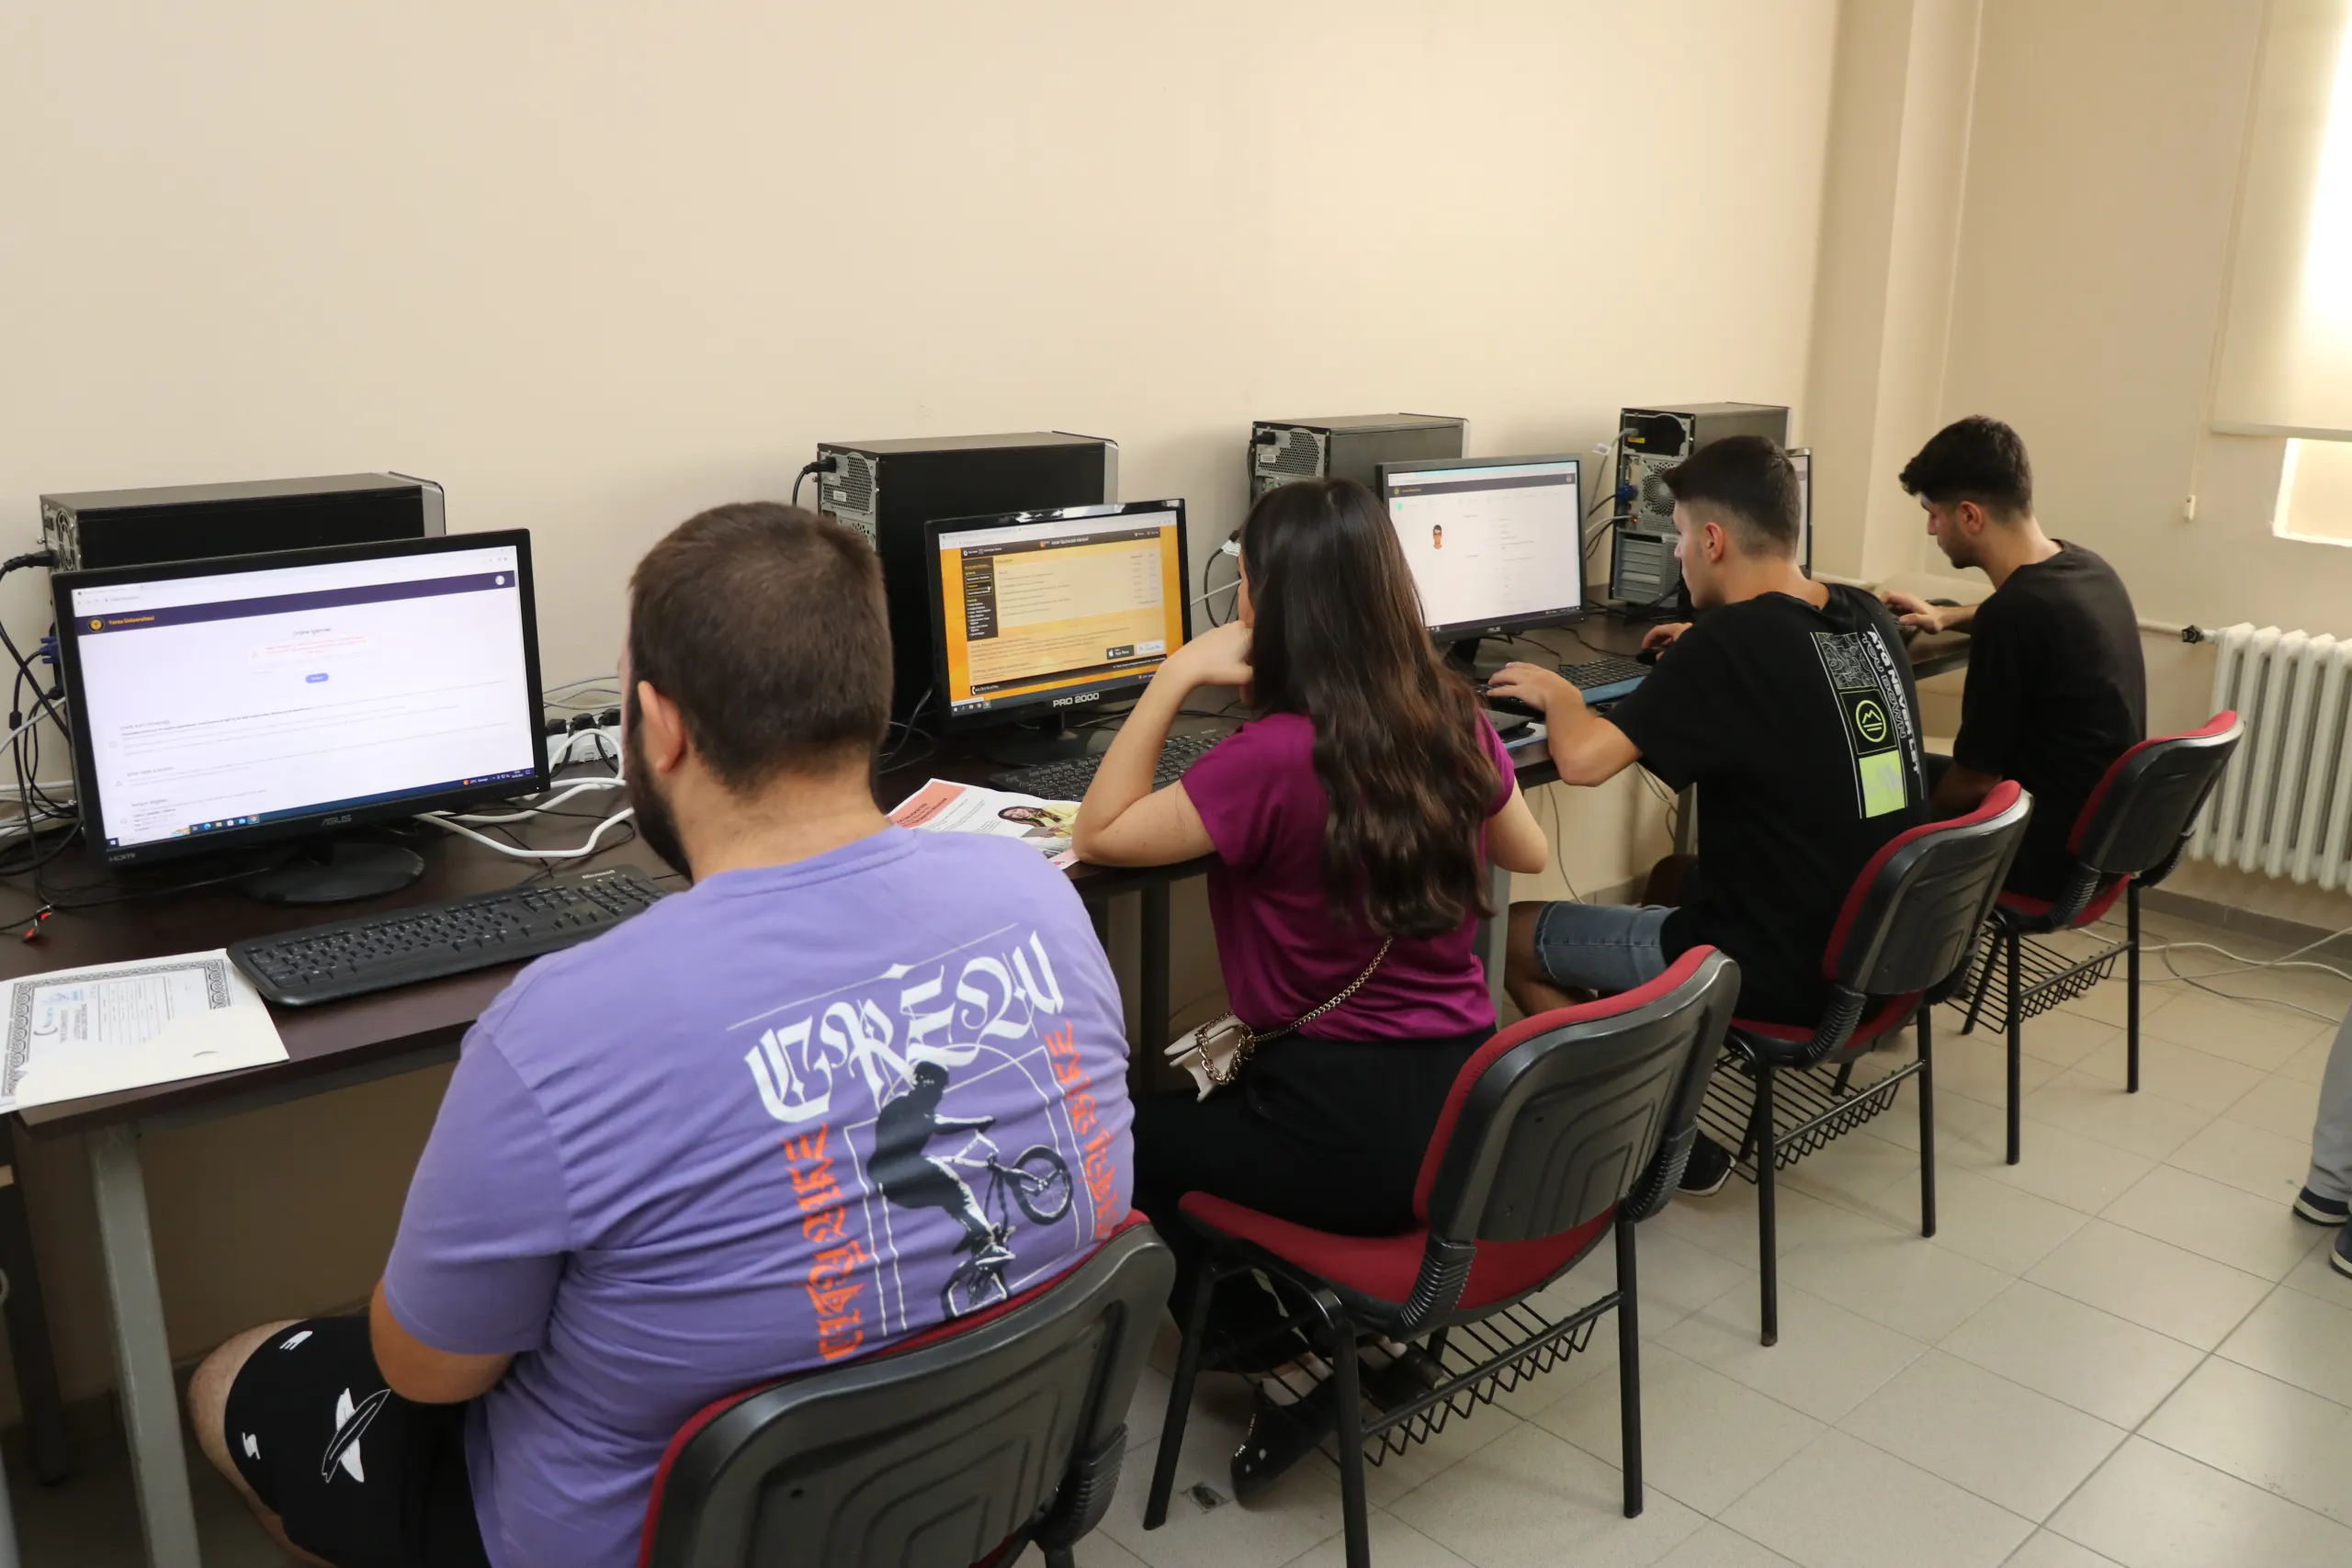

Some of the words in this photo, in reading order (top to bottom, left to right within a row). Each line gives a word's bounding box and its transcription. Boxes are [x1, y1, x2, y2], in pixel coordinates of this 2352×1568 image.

[1053, 697, 1073, 707] PRO
[1075, 693, 1100, 703] 2000
[1881, 675, 1906, 739] DOWN
[1888, 670, 1912, 735] NEVER
[1908, 739, 1920, 774] LET
[322, 815, 352, 826] ASUS
[582, 869, 616, 879] Microsoft
